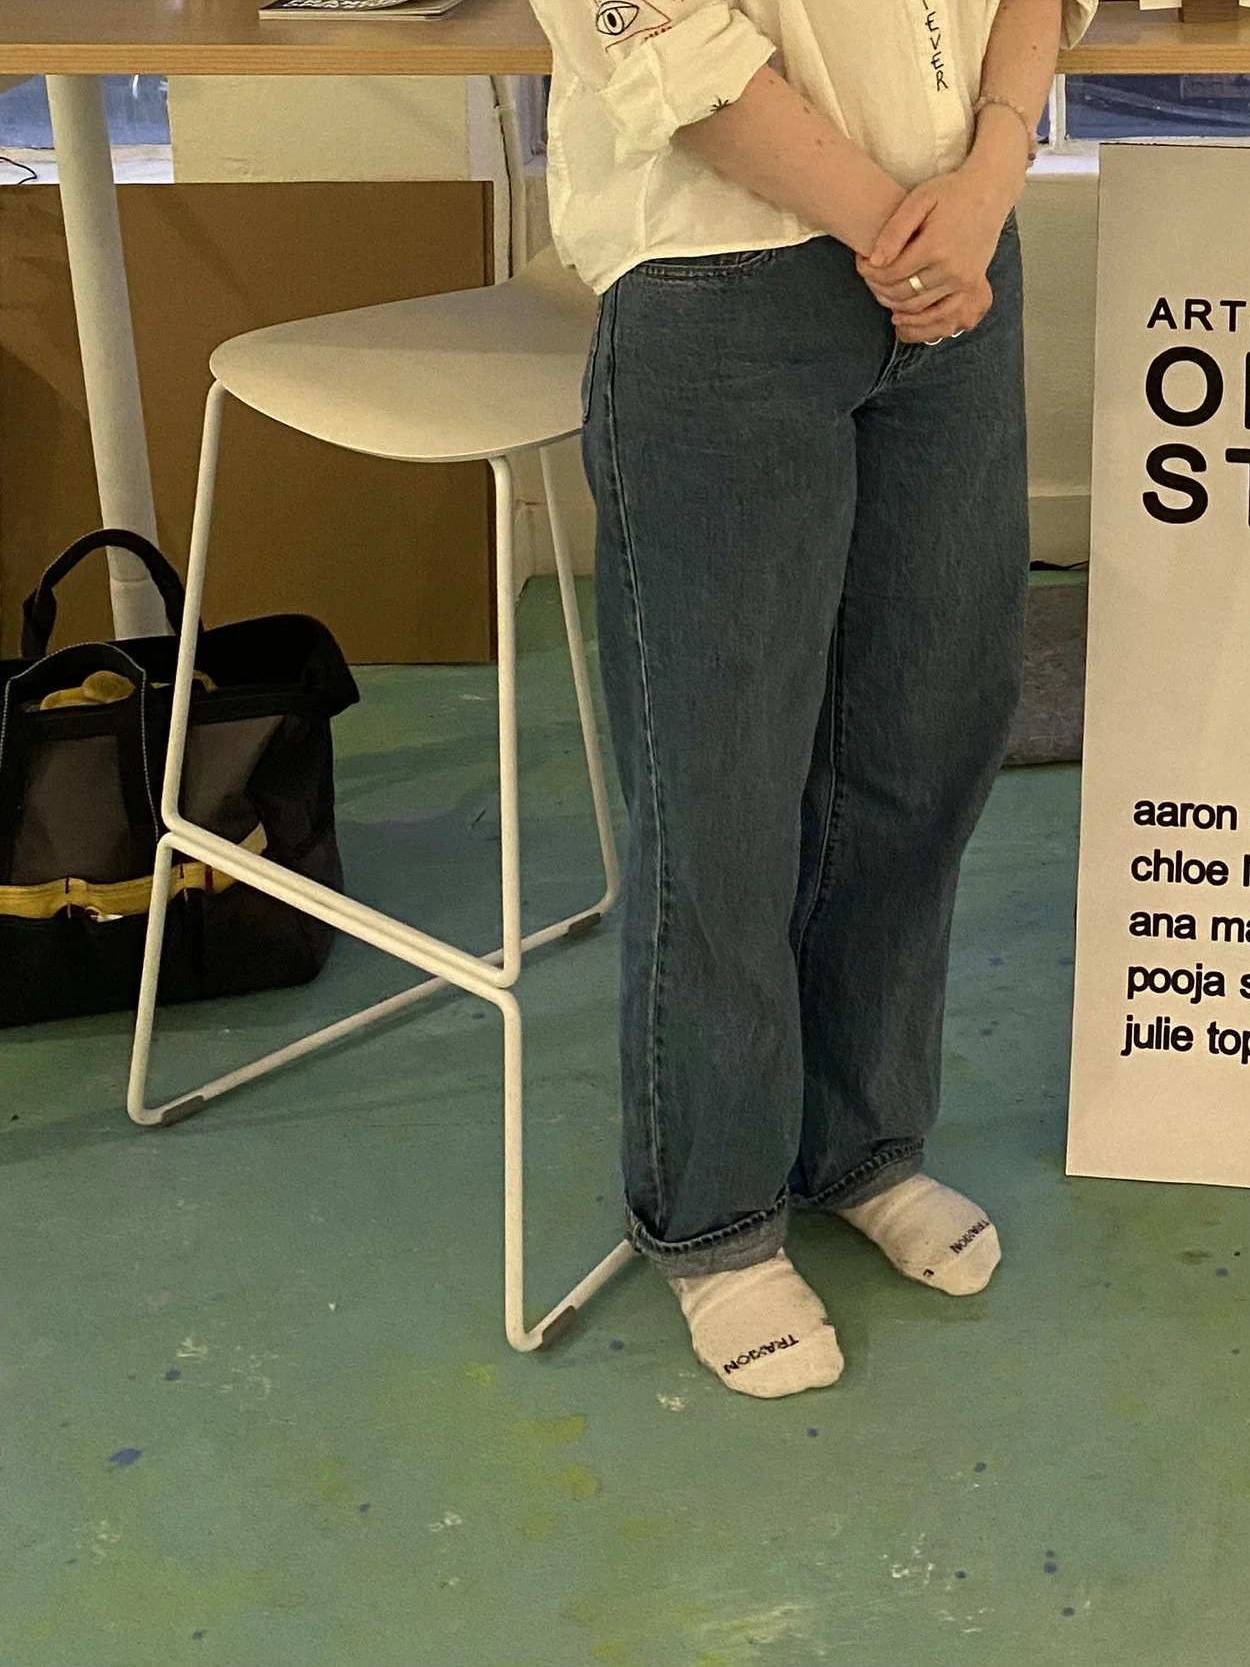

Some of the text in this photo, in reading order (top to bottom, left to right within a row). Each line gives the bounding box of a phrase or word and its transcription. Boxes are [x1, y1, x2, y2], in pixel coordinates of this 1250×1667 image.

[1133, 800, 1238, 832] aaron
[1131, 848, 1229, 887] chloe
[1128, 911, 1197, 940] ana
[1127, 962, 1226, 1005] pooja
[1120, 1014, 1194, 1057] julie
[949, 1219, 991, 1254] TRAXION
[723, 1334, 800, 1375] TRAXION
